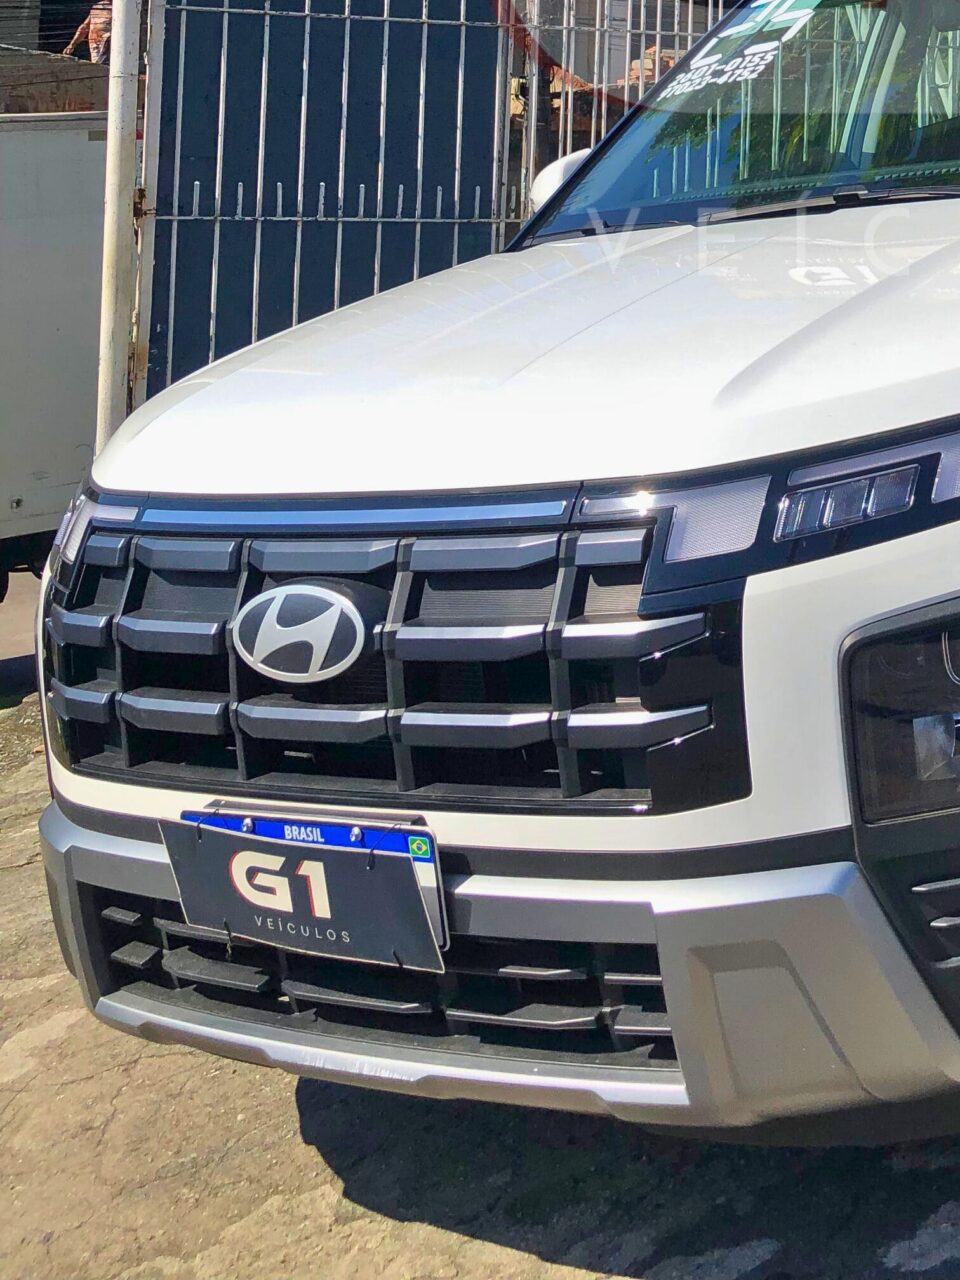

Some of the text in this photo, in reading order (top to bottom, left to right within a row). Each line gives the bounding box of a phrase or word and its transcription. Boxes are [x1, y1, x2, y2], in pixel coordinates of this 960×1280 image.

[284, 824, 325, 843] BRASIL
[228, 850, 332, 919] G1
[254, 914, 351, 943] VEÍCULOS
